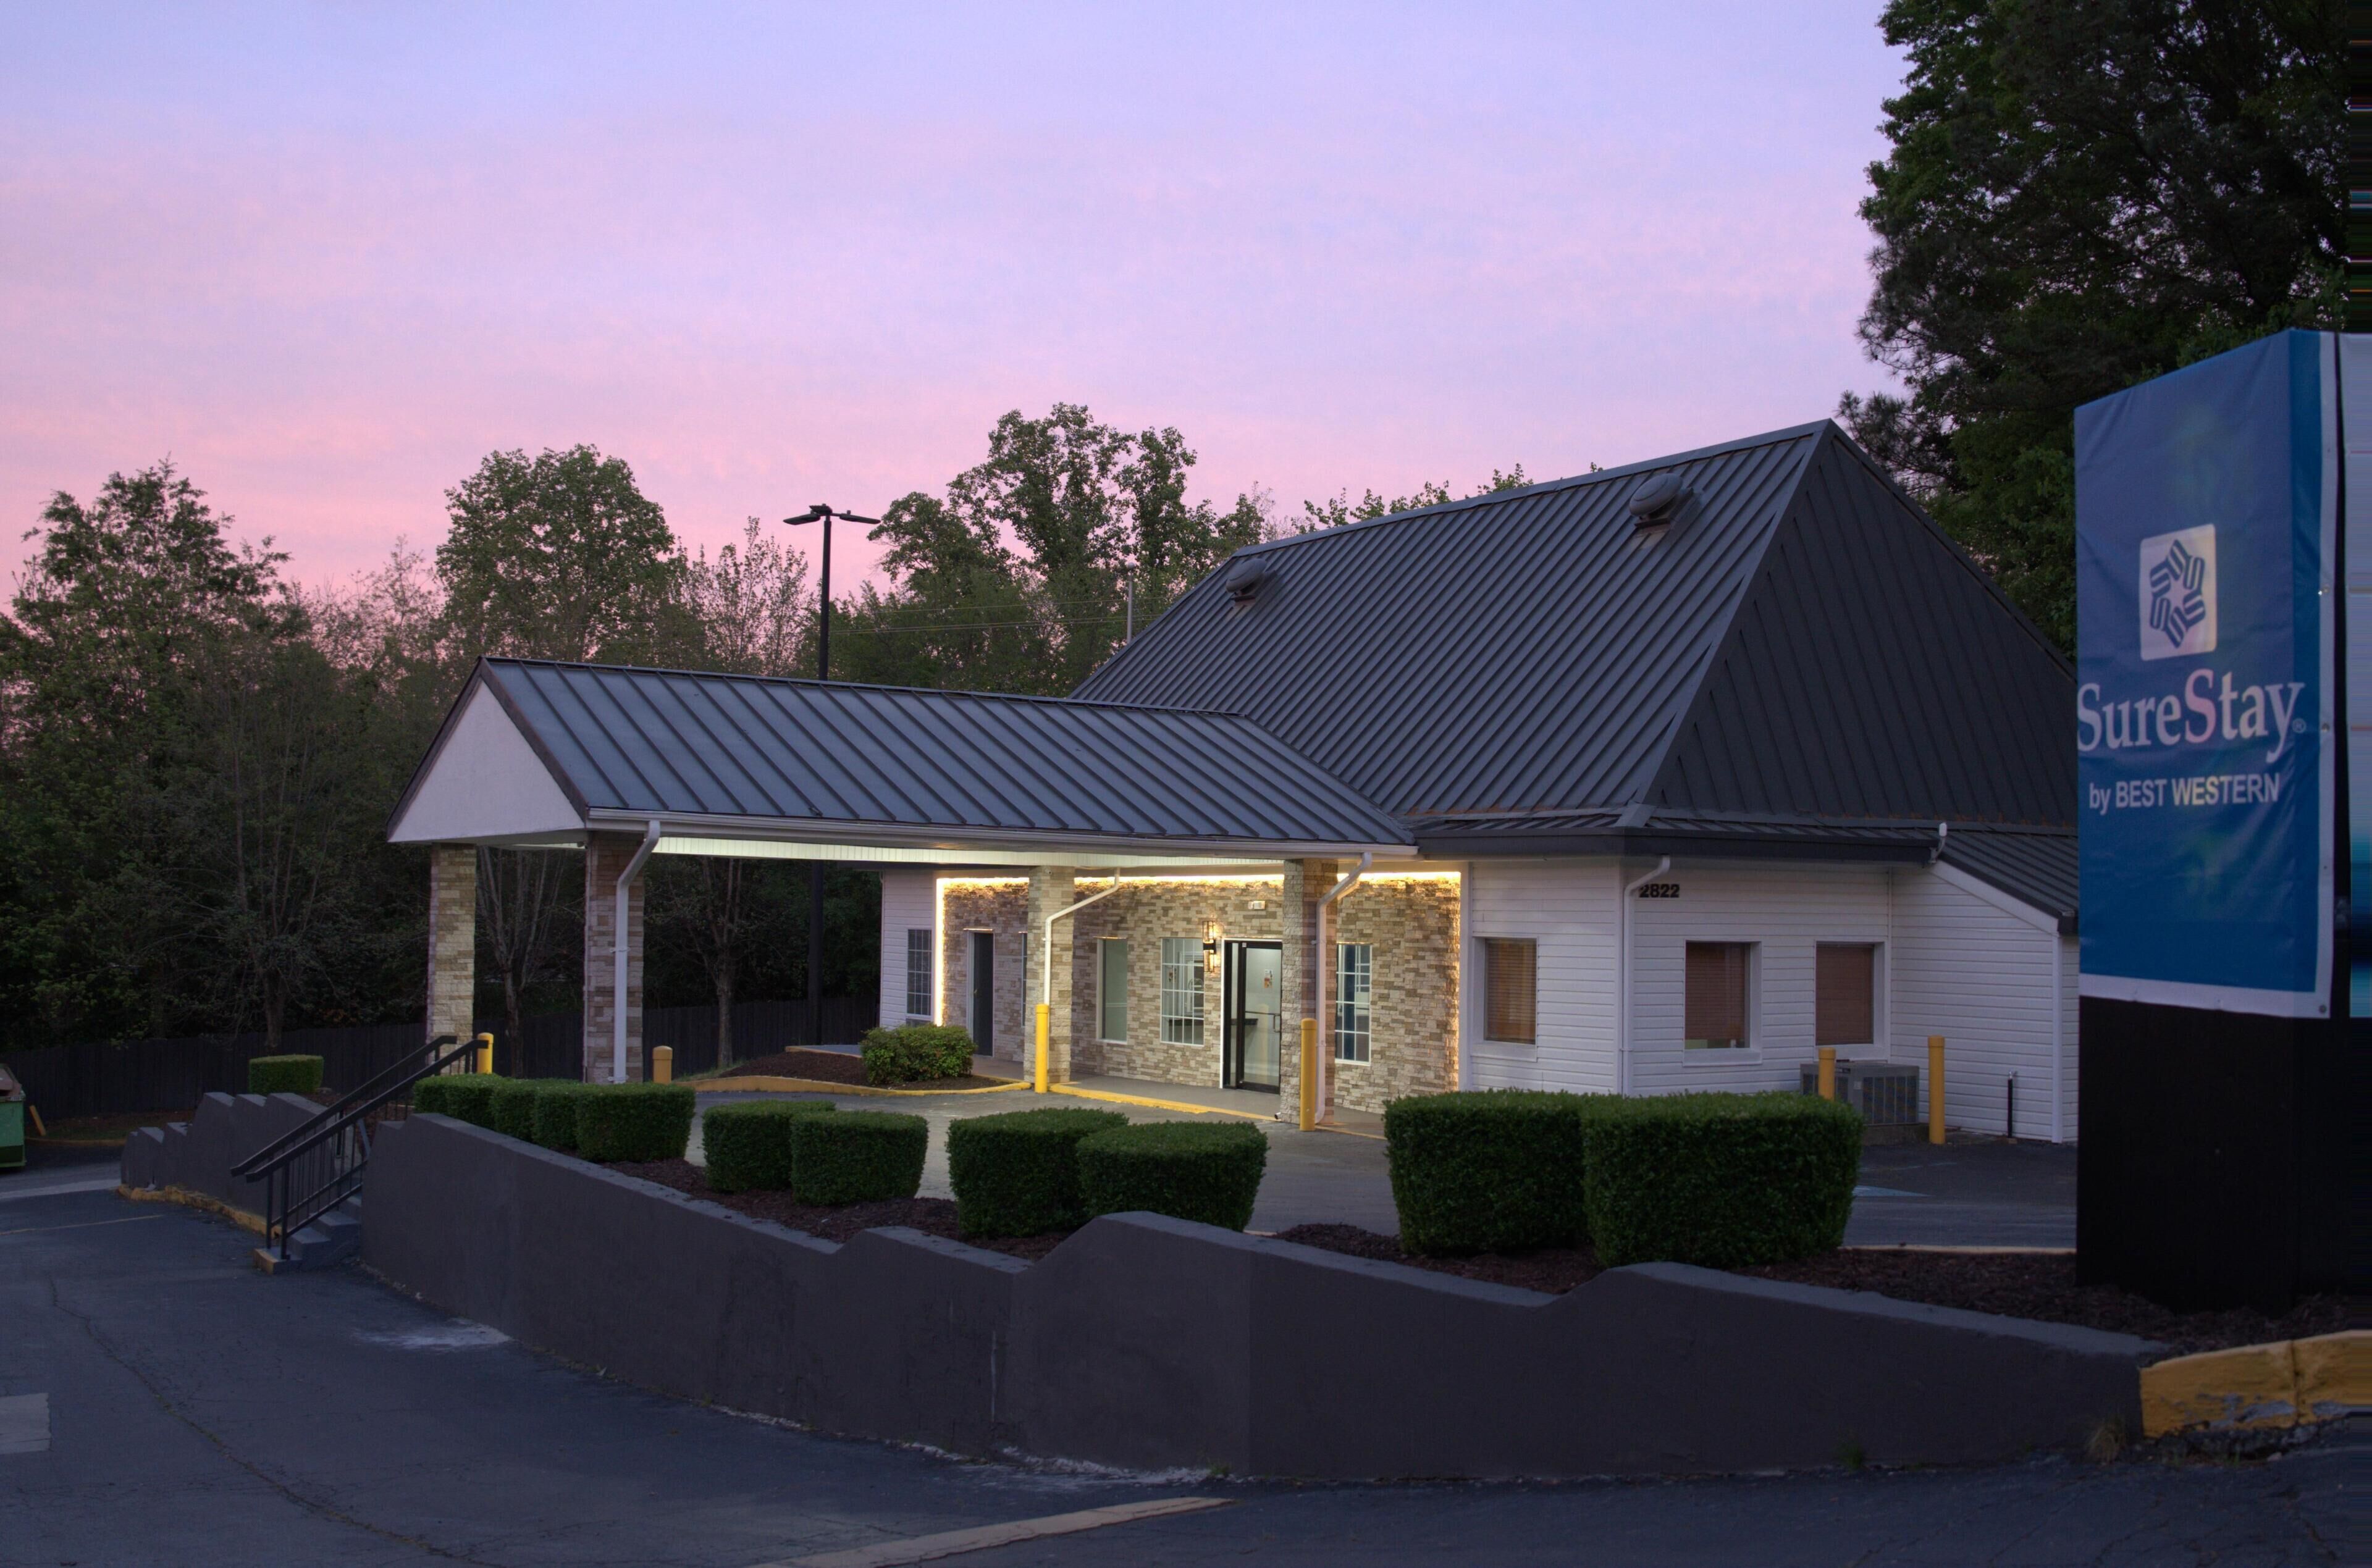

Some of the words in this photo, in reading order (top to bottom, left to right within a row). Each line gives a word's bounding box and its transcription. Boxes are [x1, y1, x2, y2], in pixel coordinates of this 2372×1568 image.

[2089, 782, 2111, 815] by
[2116, 779, 2166, 808] BEST
[2172, 773, 2280, 806] WESTERN
[1639, 883, 1680, 898] 2822
